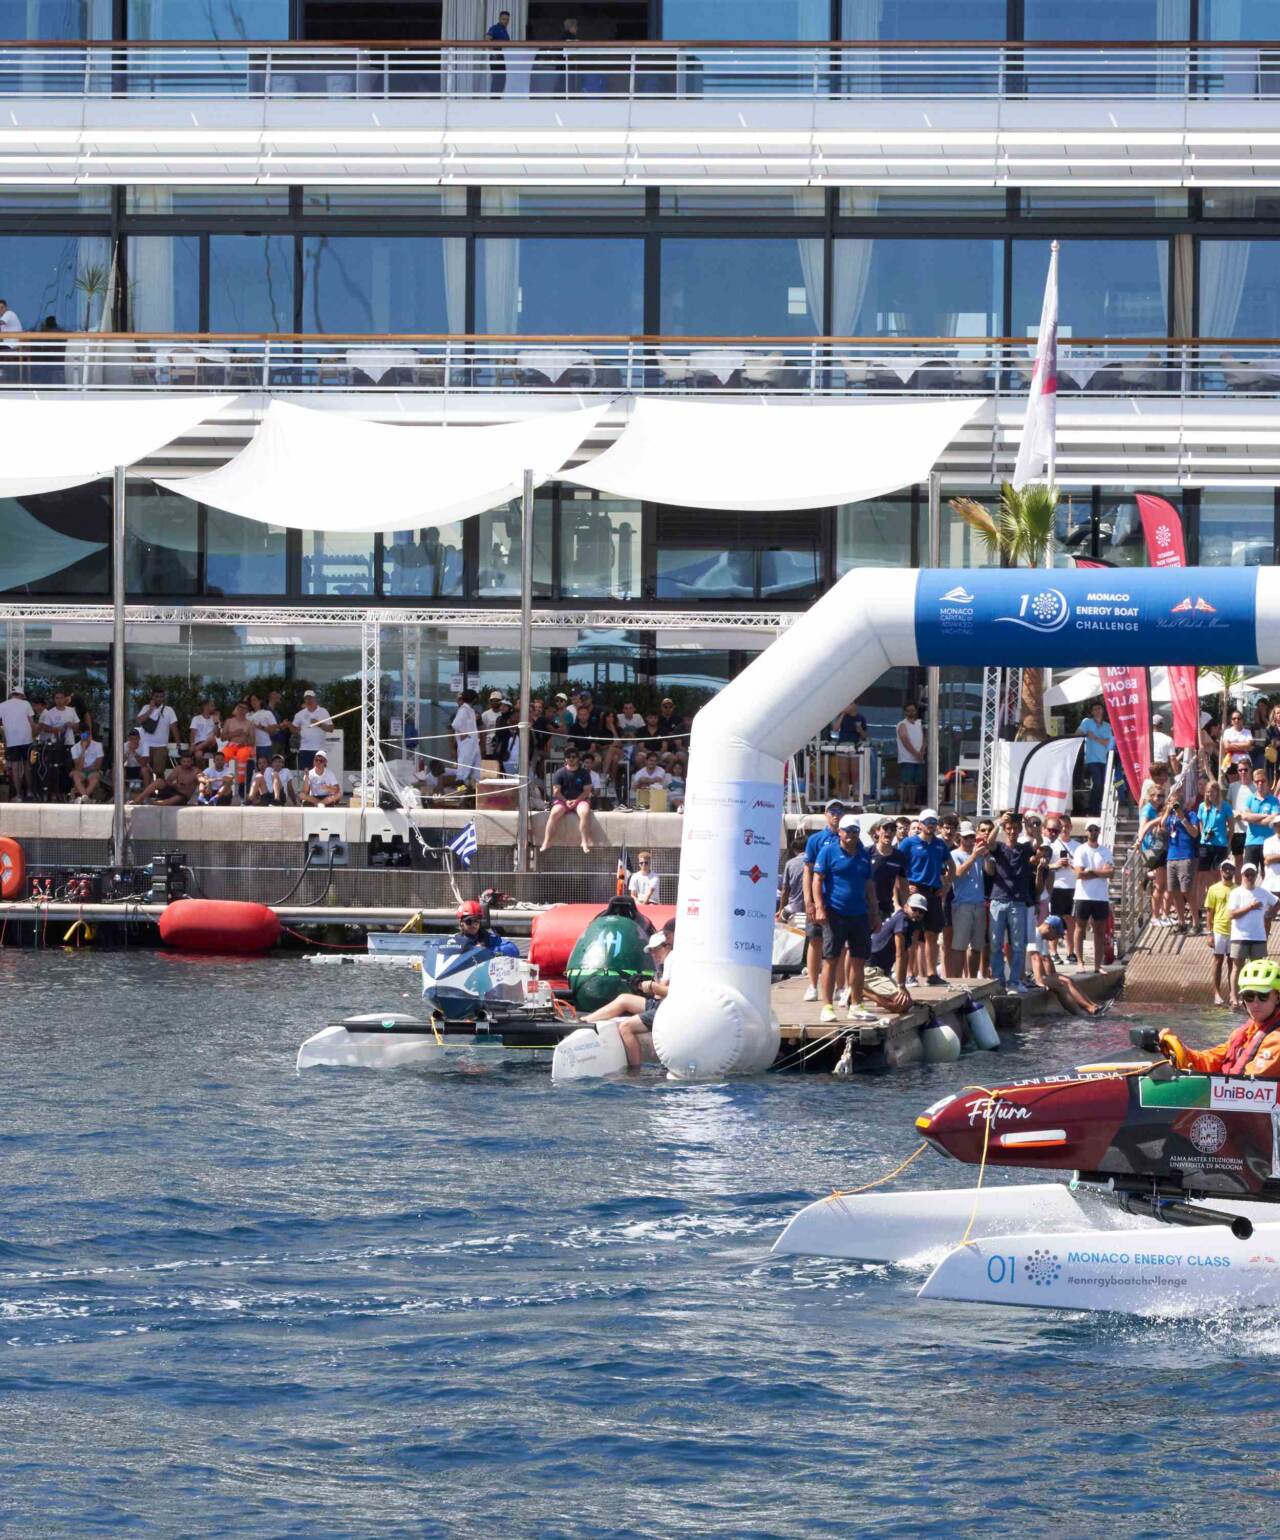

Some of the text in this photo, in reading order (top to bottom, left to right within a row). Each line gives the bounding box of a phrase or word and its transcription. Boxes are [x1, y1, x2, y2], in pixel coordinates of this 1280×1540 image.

[1087, 593, 1131, 602] MONACO
[1076, 606, 1140, 616] ENERGY BOAT
[1075, 620, 1140, 632] CHALLENGE
[1012, 1078, 1040, 1086] UNI
[1213, 1085, 1275, 1101] UniBoAT
[965, 1098, 1033, 1130] Futura
[1208, 1156, 1243, 1165] STUDIORUM
[1067, 1251, 1232, 1268] MONACO ENERGY CLASS
[987, 1255, 1016, 1285] 01
[1067, 1274, 1188, 1288] #energyboatchallenge
